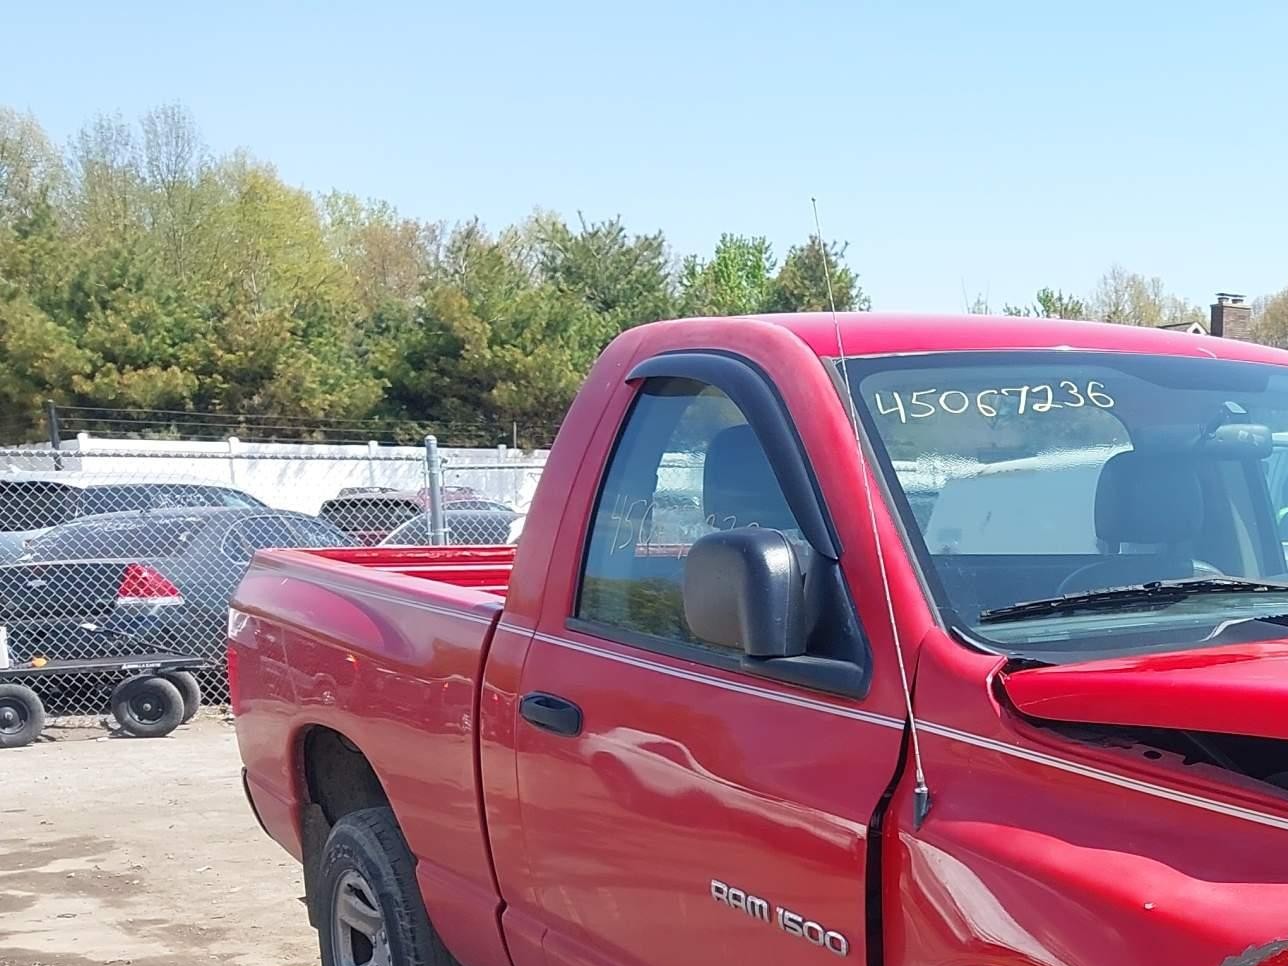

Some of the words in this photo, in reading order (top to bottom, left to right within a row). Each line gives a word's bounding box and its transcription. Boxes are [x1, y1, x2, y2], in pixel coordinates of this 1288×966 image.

[875, 380, 1115, 424] 45067236
[711, 879, 771, 924] RAM
[776, 906, 849, 959] 1500
